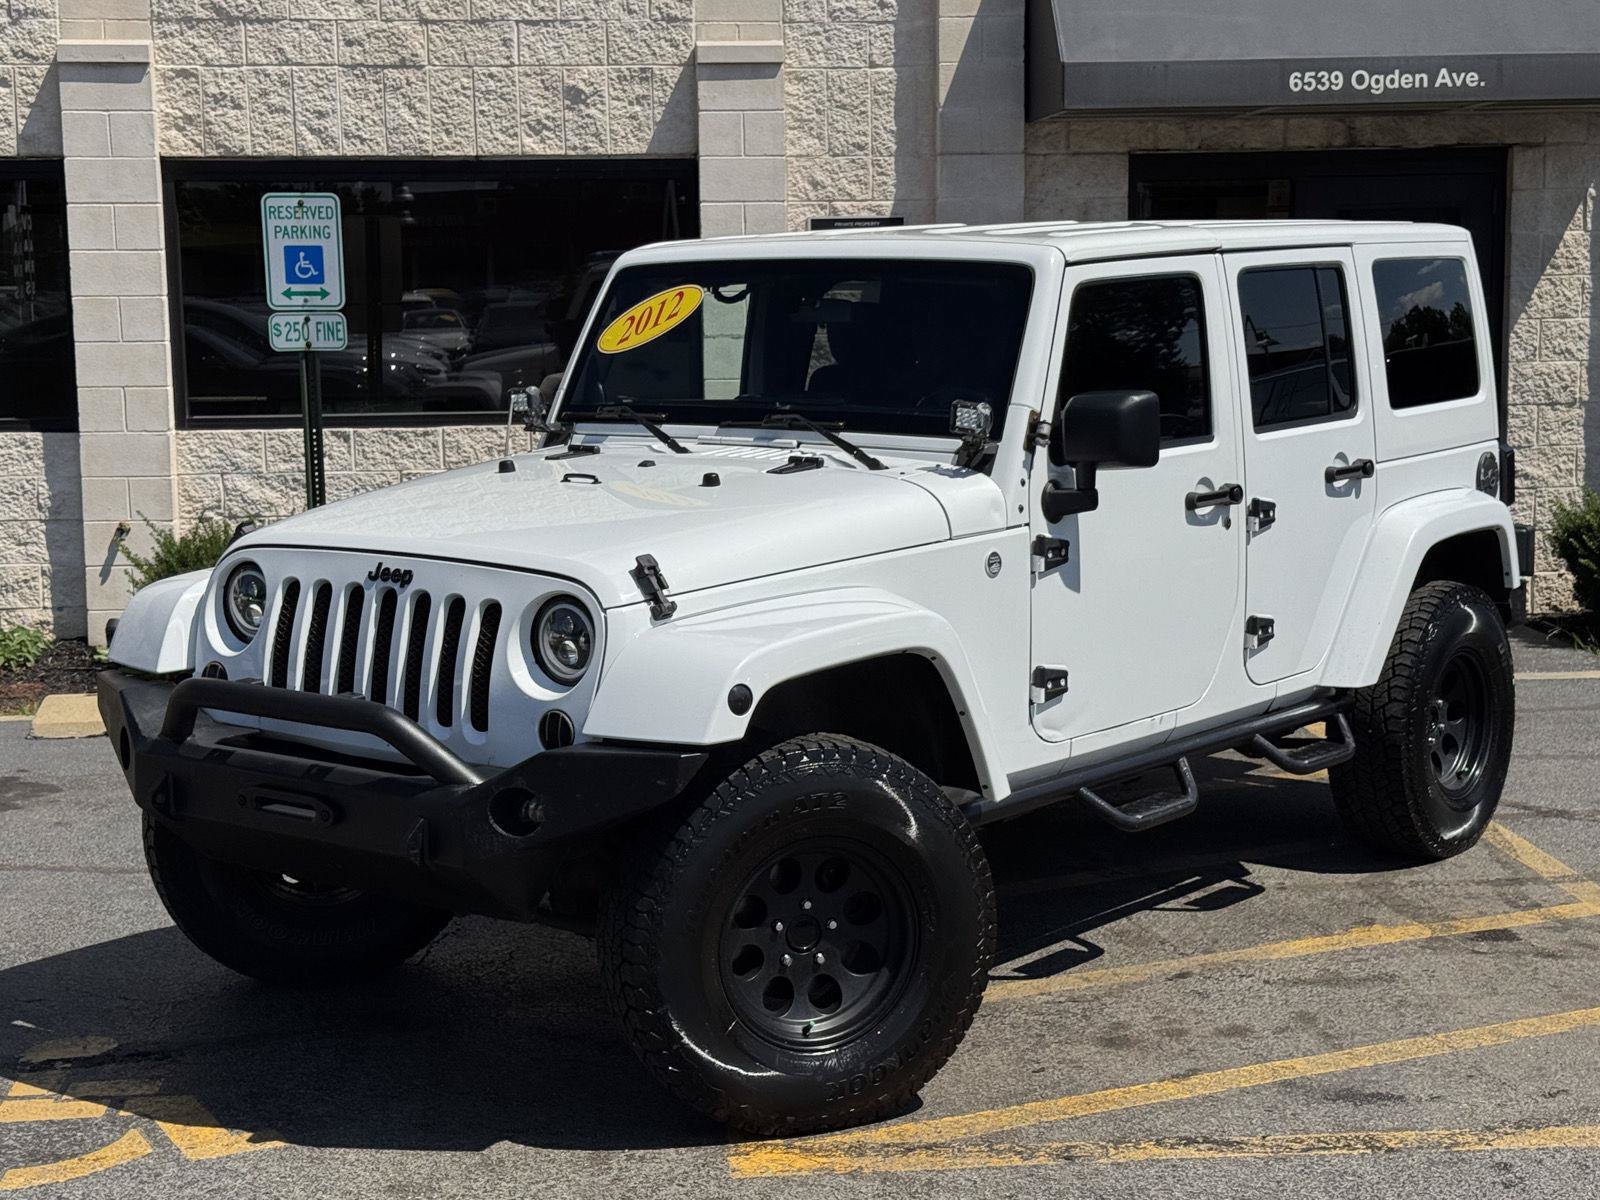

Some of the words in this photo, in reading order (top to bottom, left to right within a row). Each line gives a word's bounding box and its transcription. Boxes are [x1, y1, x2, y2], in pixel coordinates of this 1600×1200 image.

[1288, 71, 1344, 92] 6539
[1350, 69, 1429, 95] Ogden
[1434, 67, 1486, 88] Ave.
[268, 205, 334, 220] RESERVED
[274, 225, 331, 240] PARKING
[616, 290, 685, 346] 2012
[272, 321, 310, 342] $250
[315, 321, 344, 342] FINE
[367, 561, 414, 589] Jeep
